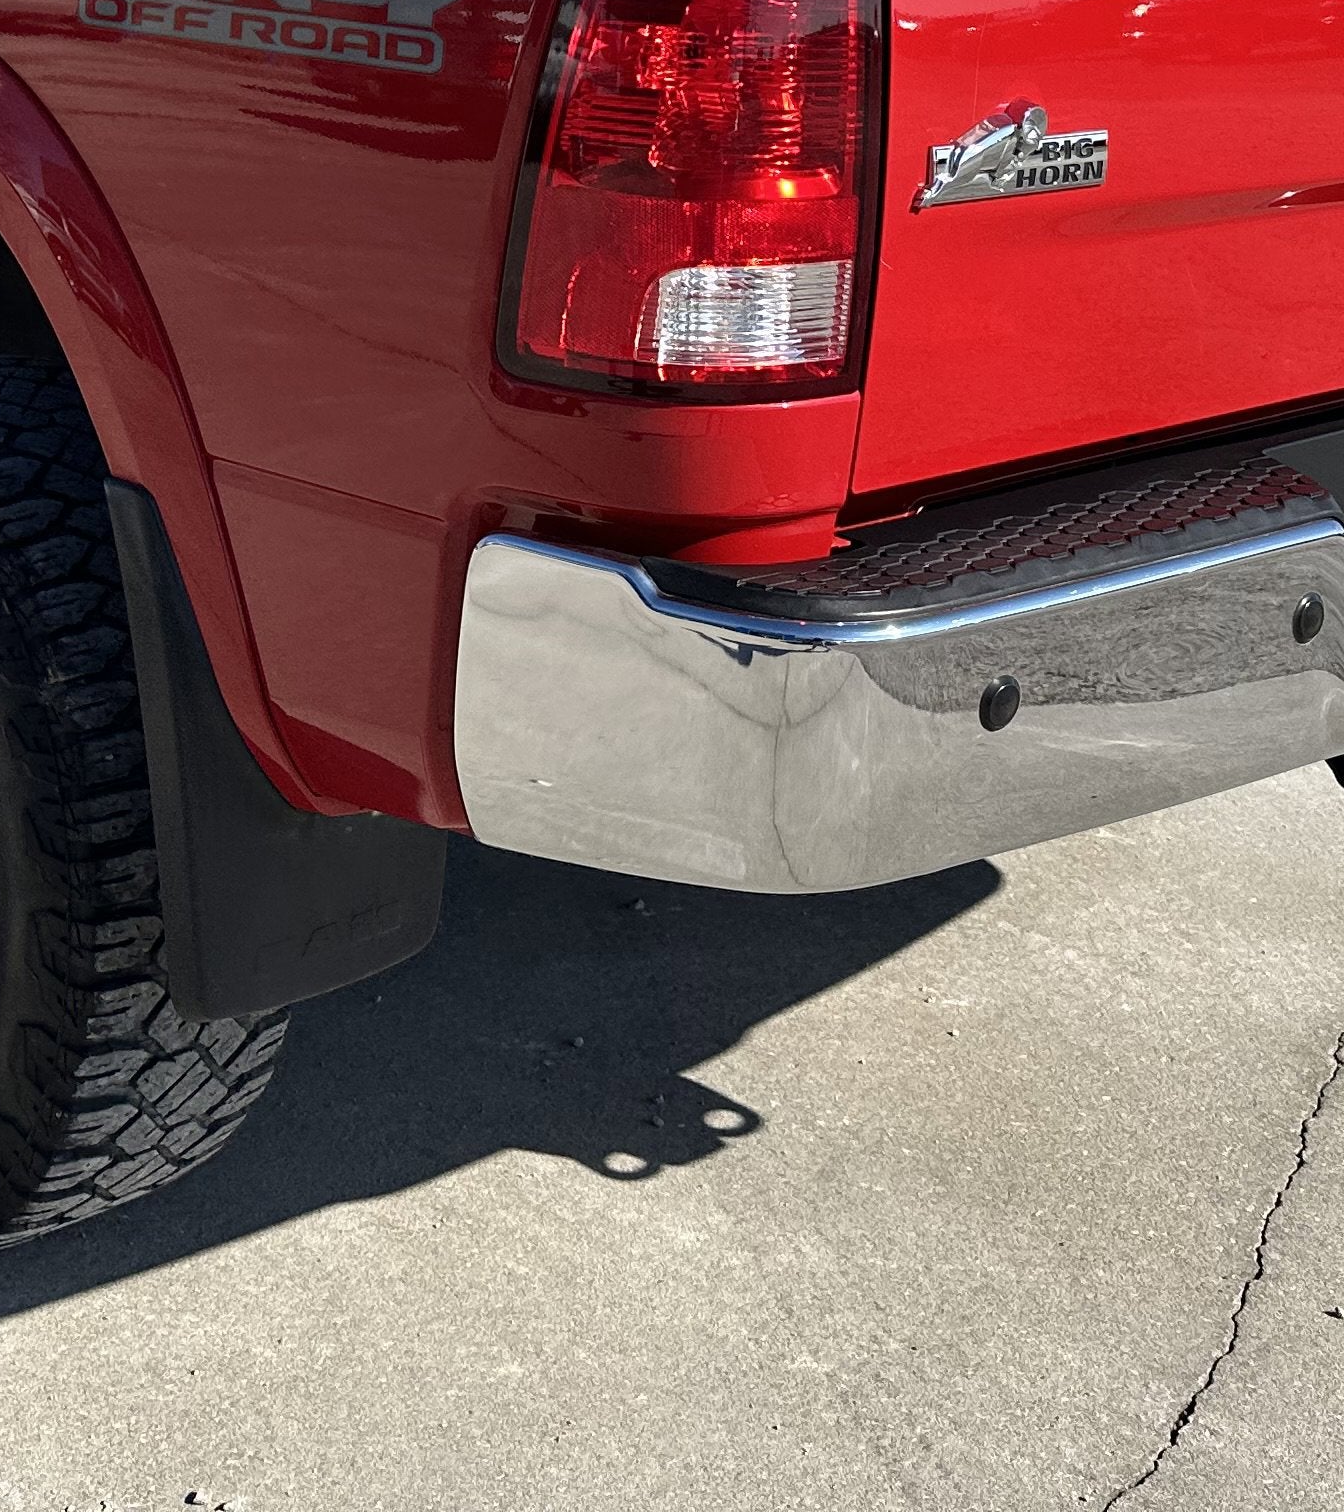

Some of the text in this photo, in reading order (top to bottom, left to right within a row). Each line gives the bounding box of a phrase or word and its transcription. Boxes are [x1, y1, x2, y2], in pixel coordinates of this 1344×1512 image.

[229, 13, 435, 65] ROAD
[1042, 137, 1094, 163] BIG
[1015, 160, 1104, 188] HORN
